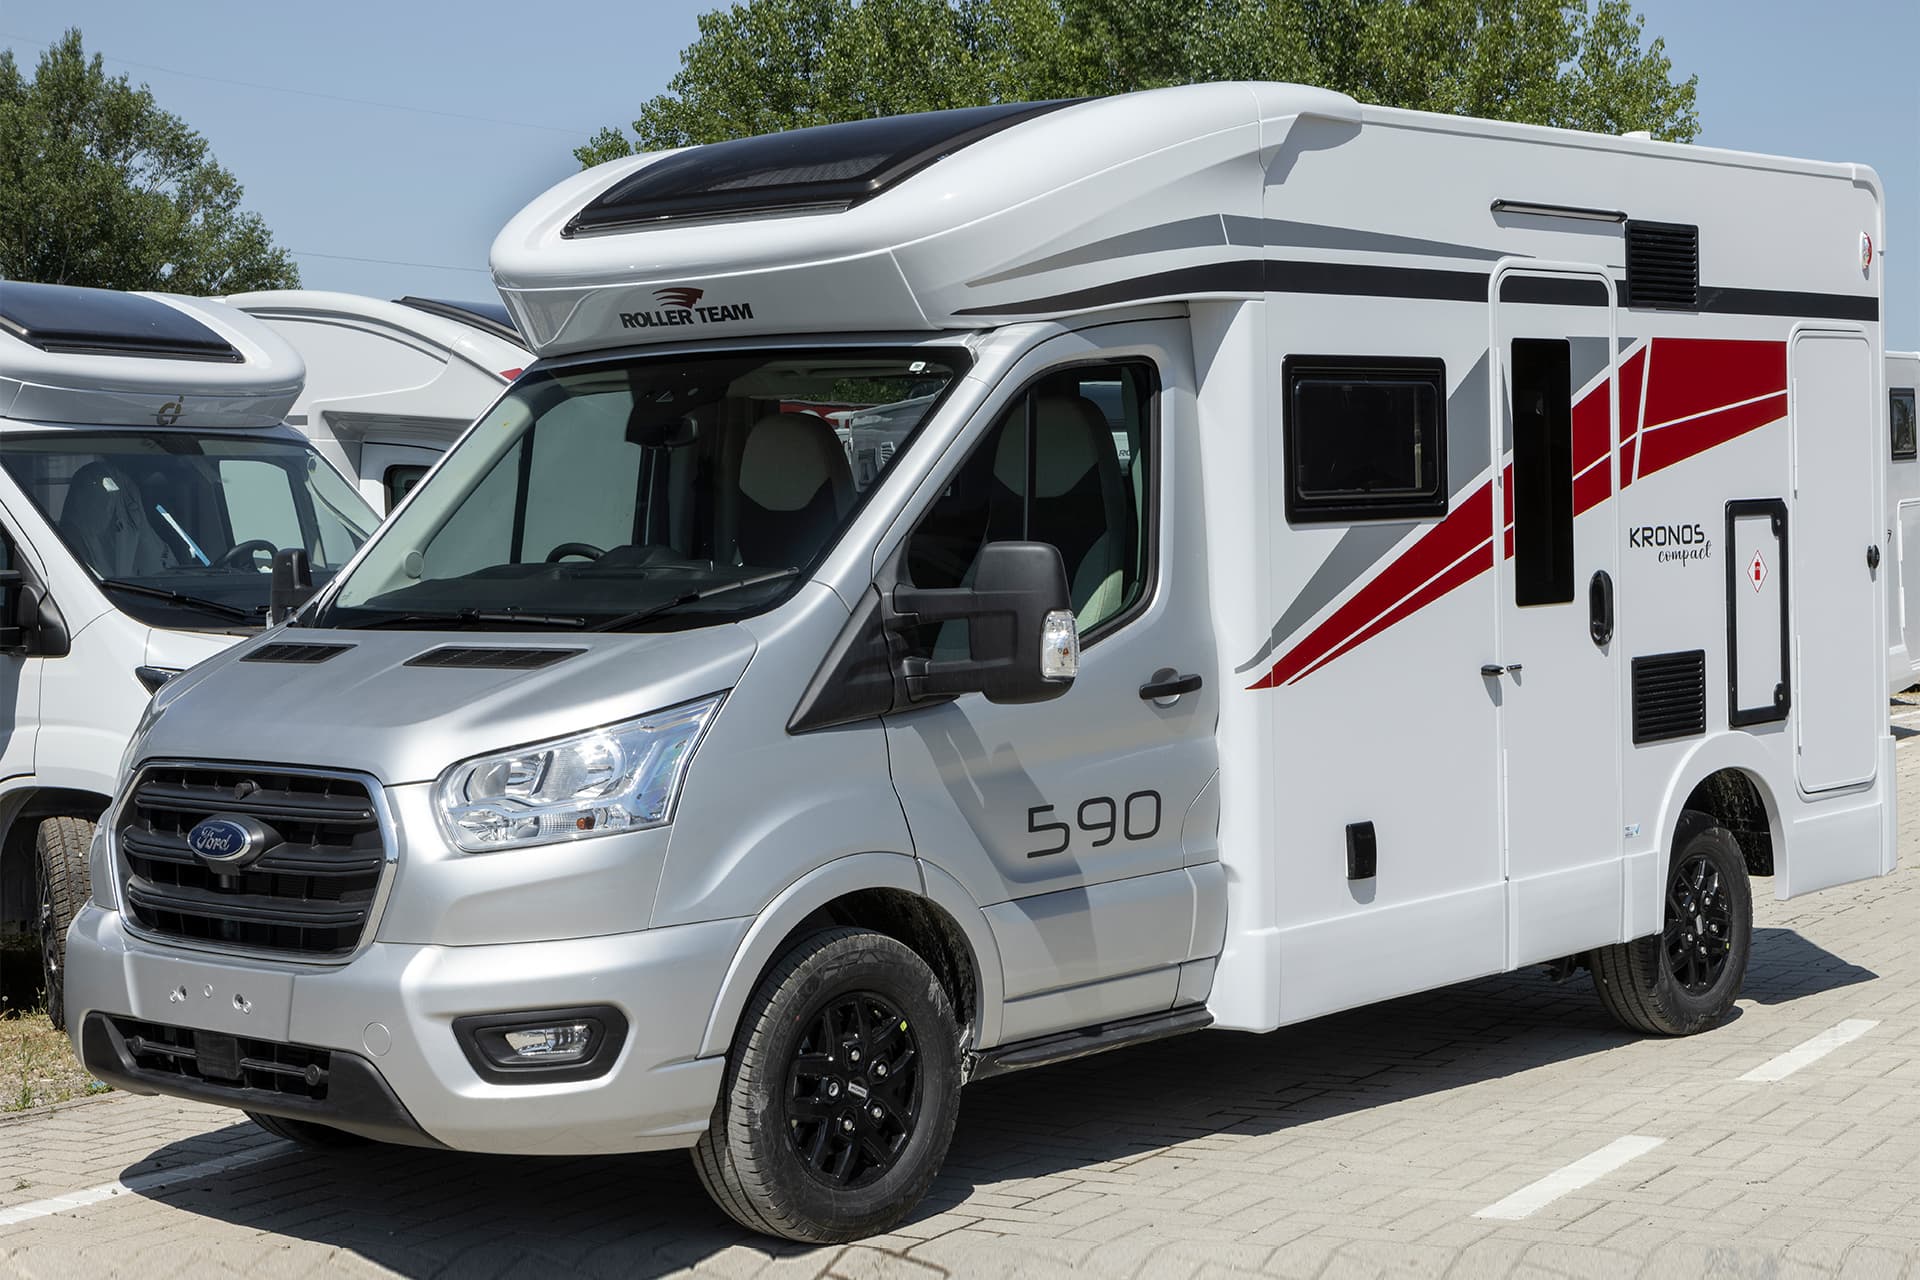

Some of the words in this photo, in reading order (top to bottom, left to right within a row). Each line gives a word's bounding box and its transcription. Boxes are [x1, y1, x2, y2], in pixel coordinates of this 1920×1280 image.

[619, 309, 694, 328] ROLLER
[695, 303, 754, 323] TEAM
[1629, 524, 1705, 548] KRONOS
[1658, 540, 1712, 567] compact
[1027, 790, 1162, 859] 590
[196, 826, 232, 851] Ford
